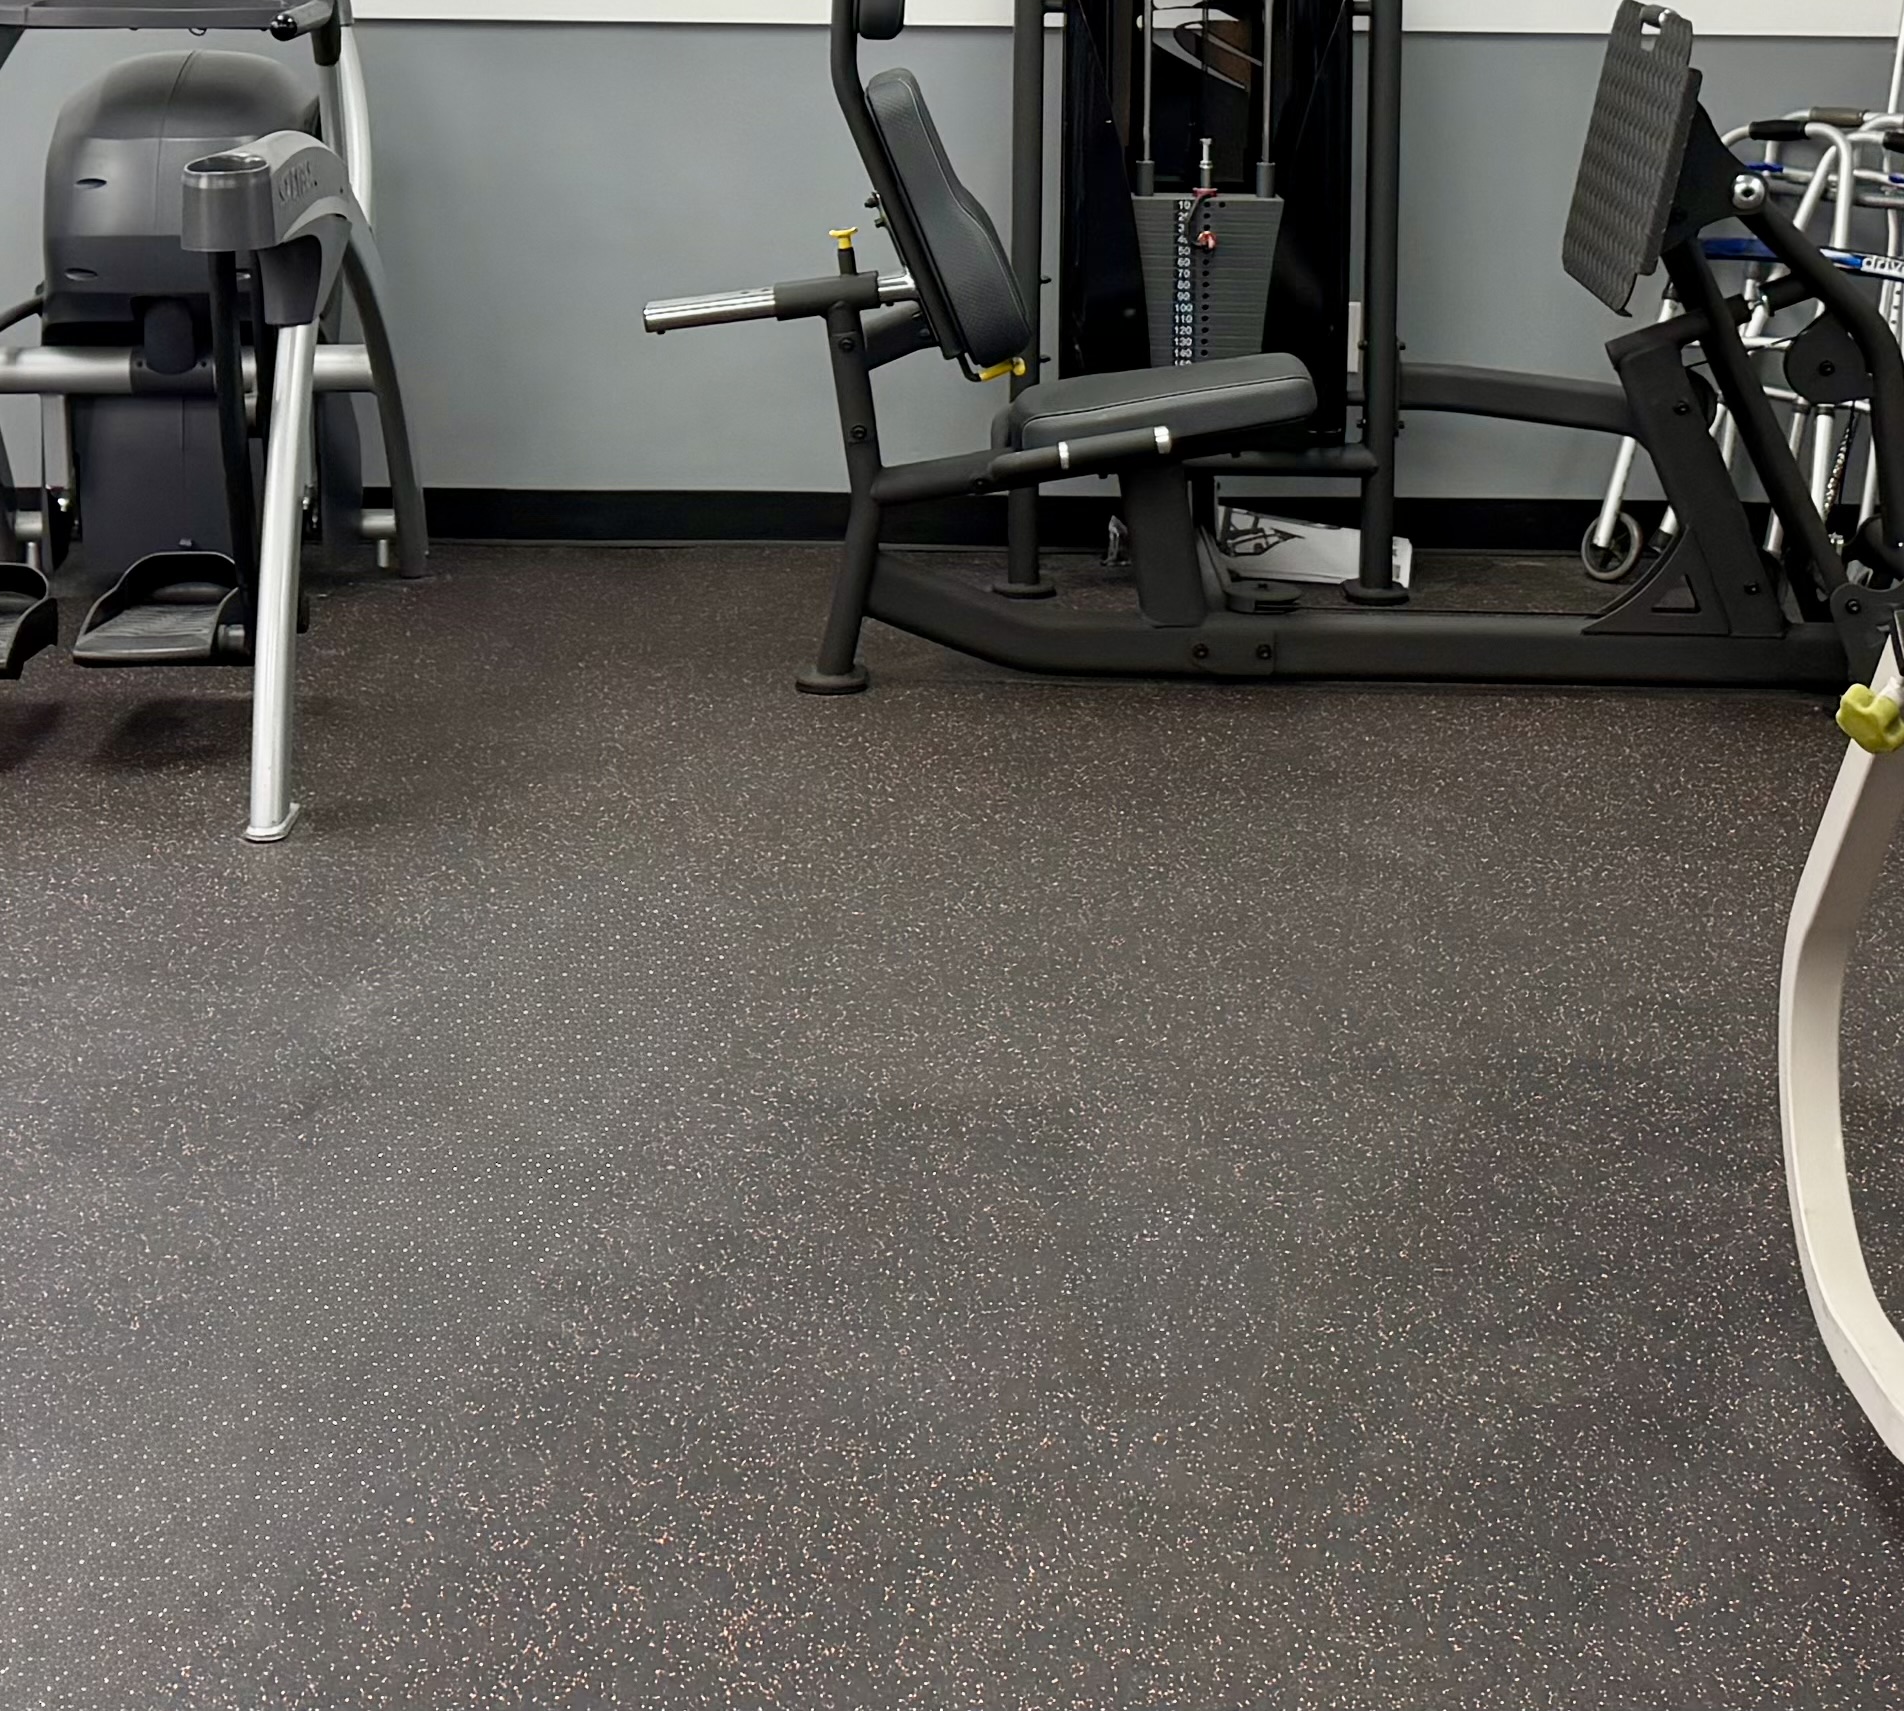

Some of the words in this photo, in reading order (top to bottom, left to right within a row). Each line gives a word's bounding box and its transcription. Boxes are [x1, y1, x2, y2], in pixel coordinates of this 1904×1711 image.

[1178, 200, 1191, 210] 10
[1177, 247, 1191, 255] 50
[1177, 258, 1191, 266] 60
[1177, 269, 1191, 278] 70
[1177, 280, 1191, 289] 80
[1177, 291, 1190, 300] 90
[1174, 303, 1193, 312] 100
[1174, 314, 1193, 323] 110
[1174, 326, 1192, 335] 120
[1174, 337, 1192, 346] 130
[1174, 348, 1192, 357] 140
